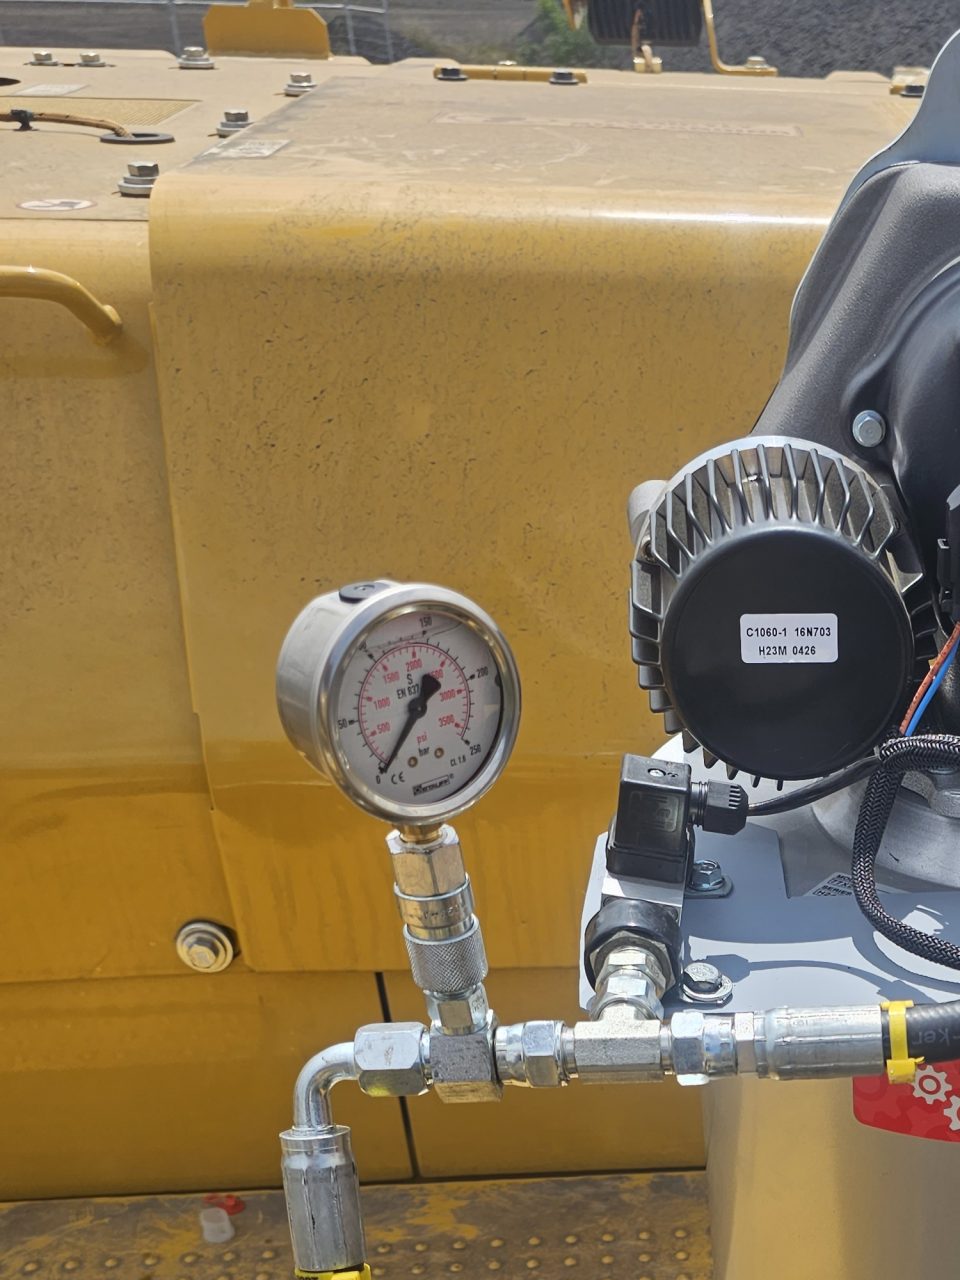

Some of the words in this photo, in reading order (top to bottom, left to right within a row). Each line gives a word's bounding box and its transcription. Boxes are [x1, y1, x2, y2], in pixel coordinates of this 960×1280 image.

[419, 616, 433, 628] 150
[746, 627, 788, 638] C1060-1
[794, 627, 831, 637] 16N703
[758, 645, 788, 656] H23M
[792, 645, 816, 656] 0426
[405, 658, 423, 673] 2000
[476, 666, 490, 677] 200
[383, 671, 401, 685] 1500
[396, 686, 407, 700] EN
[439, 688, 457, 701] 3000
[374, 696, 391, 710] 1000
[337, 718, 348, 730] 50
[376, 721, 391, 733] 500
[438, 714, 456, 728] 3500
[416, 732, 428, 744] psi
[418, 744, 430, 756] bar
[469, 744, 482, 756] 250
